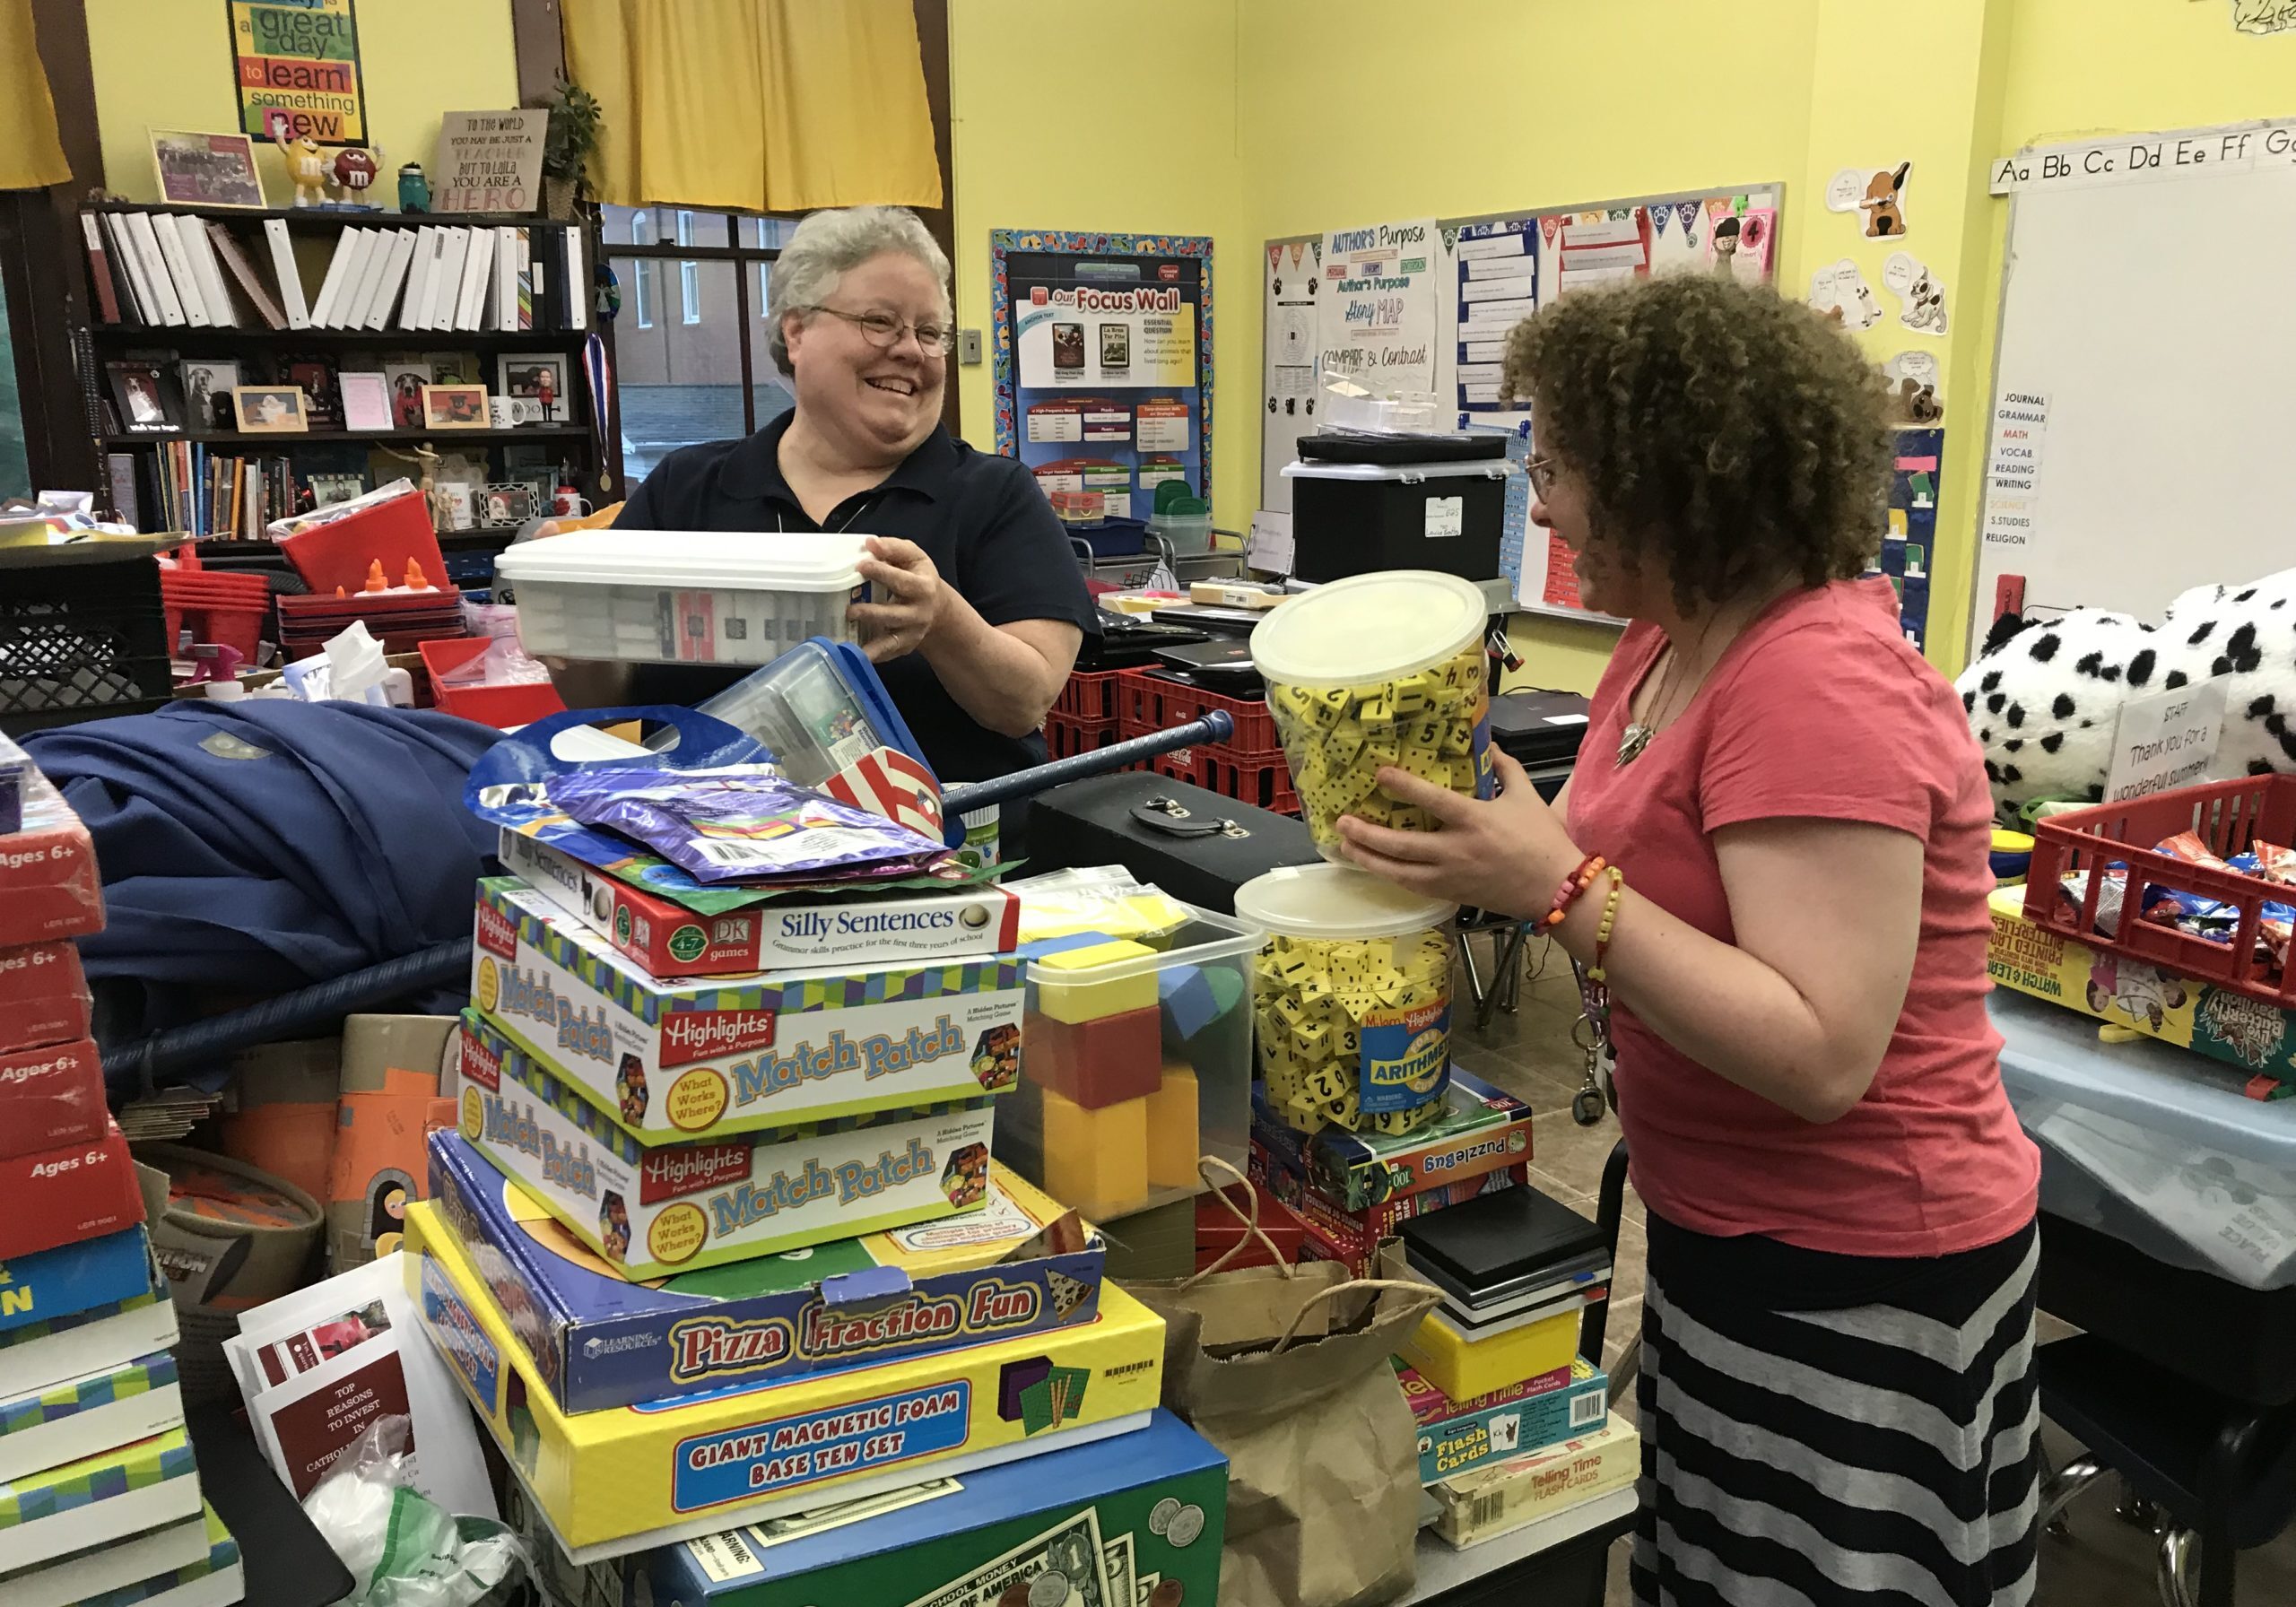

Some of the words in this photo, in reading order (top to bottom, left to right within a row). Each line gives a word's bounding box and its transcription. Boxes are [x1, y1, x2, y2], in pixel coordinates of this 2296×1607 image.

[239, 20, 251, 32] a
[259, 9, 345, 39] great
[279, 30, 328, 60] day
[245, 65, 263, 79] to
[264, 58, 345, 91] learn
[251, 91, 354, 116] something
[270, 112, 339, 137] new
[467, 118, 478, 132] TO
[499, 117, 525, 132] WORLD
[451, 136, 468, 145] YOU
[489, 135, 501, 144] BE
[502, 135, 524, 143] JUST
[525, 135, 532, 143] A
[1997, 160, 2030, 183] Aa
[2043, 154, 2071, 178] Bb
[2083, 151, 2114, 174] Cc
[2129, 143, 2161, 170] Dd
[2176, 140, 2206, 165] Ee
[2221, 134, 2251, 161] Ff
[452, 178, 481, 187] YOU
[483, 177, 509, 187] ARE
[512, 175, 522, 187] A
[441, 187, 526, 211] HERO
[1332, 229, 1375, 254] AUTHOR'S
[1379, 225, 1425, 250] Purpose
[1748, 221, 1759, 242] 4
[1337, 279, 1371, 293] Author's
[1374, 276, 1410, 292] Purpose
[1054, 292, 1074, 304] Our
[1077, 290, 1133, 309] Focus
[1135, 291, 1178, 311] Wall
[1345, 300, 1375, 326] Story
[1376, 298, 1405, 325] MAP
[1368, 351, 1377, 367] &
[1382, 343, 1427, 367] Contrast
[2005, 393, 2045, 405] JOURNAL
[1998, 410, 2046, 423] GRAMMAR
[2004, 430, 2028, 439] MATH
[1996, 464, 2034, 474] READING
[1996, 479, 2031, 490] WRITING
[1990, 500, 2026, 510] SCIENCE
[1991, 517, 2031, 527] S.STUDIES
[1986, 533, 2025, 545] RELIGION
[2164, 702, 2188, 723] STAFF
[2131, 740, 2163, 768] Thank
[2164, 734, 2183, 756] you
[2184, 728, 2200, 749] for
[2201, 726, 2207, 743] a
[2113, 771, 2168, 803] wonderful
[51, 846, 74, 859] 6+
[718, 921, 749, 941] DK
[781, 912, 832, 942] Silly
[836, 908, 954, 934] Sentences
[676, 935, 700, 950] 4-7
[710, 946, 749, 961] games
[771, 938, 809, 955] Grammar
[811, 942, 830, 954] skills
[831, 942, 865, 955] practice
[865, 937, 878, 948] for
[878, 937, 891, 947] the
[893, 937, 908, 948] first
[909, 940, 927, 951] three
[929, 941, 949, 951] years
[950, 937, 959, 946] of
[960, 932, 983, 942] school
[1990, 933, 2012, 951] LAD
[2015, 939, 2063, 967] PAINTED
[2013, 969, 2021, 983] &
[2022, 970, 2061, 996] WATCH
[500, 964, 556, 1027] Match
[556, 995, 614, 1065] Patch
[665, 1012, 769, 1047] Highlights
[692, 1048, 708, 1058] Fun
[709, 1045, 726, 1055] with
[735, 1038, 766, 1048] Purpose
[1, 1063, 50, 1083] Ages
[57, 1056, 79, 1072] 6+
[730, 1029, 861, 1108] Match
[861, 1013, 966, 1081] Patch
[679, 1076, 712, 1091] What
[675, 1099, 722, 1120] Where?
[677, 1090, 716, 1107] Works
[483, 1093, 541, 1160] Match
[540, 1129, 596, 1201] Patch
[1423, 1137, 1505, 1175] PuzzleBug
[30, 1157, 80, 1178] Ages
[85, 1151, 108, 1165] 6+
[646, 1148, 744, 1183] Highlights
[673, 1184, 687, 1194] Fun
[712, 1169, 744, 1183] Purpose
[709, 1158, 834, 1239] Match
[834, 1137, 935, 1207] Patch
[660, 1211, 692, 1227] What
[657, 1223, 696, 1240] Works
[657, 1232, 701, 1254] Where?
[604, 1332, 653, 1347] LEARNING
[677, 1326, 785, 1372] Pizza
[811, 1300, 953, 1351] Fraction
[970, 1287, 1031, 1325] Fun
[604, 1339, 657, 1355] RESOURCES
[335, 1382, 355, 1399] TOP
[1526, 1383, 1543, 1394] Flash
[1544, 1379, 1561, 1390] Cards
[1534, 1375, 1554, 1386] Pocket
[326, 1388, 374, 1419] REASONS
[328, 1420, 344, 1432] TO
[344, 1399, 381, 1425] INVEST
[352, 1421, 366, 1435] IN
[691, 1435, 766, 1471] GIANT
[774, 1404, 891, 1450] MAGNETIC
[895, 1390, 960, 1429] FOAM
[1436, 1427, 1489, 1458] Flash
[750, 1454, 811, 1487] BASE
[817, 1443, 859, 1476] TEN
[865, 1433, 905, 1462] SET
[1436, 1441, 1490, 1472] Cards
[1531, 1466, 1570, 1490] Telling
[1572, 1455, 1603, 1474] Time
[1535, 1483, 1566, 1502] FLASH
[1567, 1469, 1599, 1490] CARDS
[975, 1557, 1021, 1586] MONEY
[981, 1560, 1043, 1604] AMERICA
